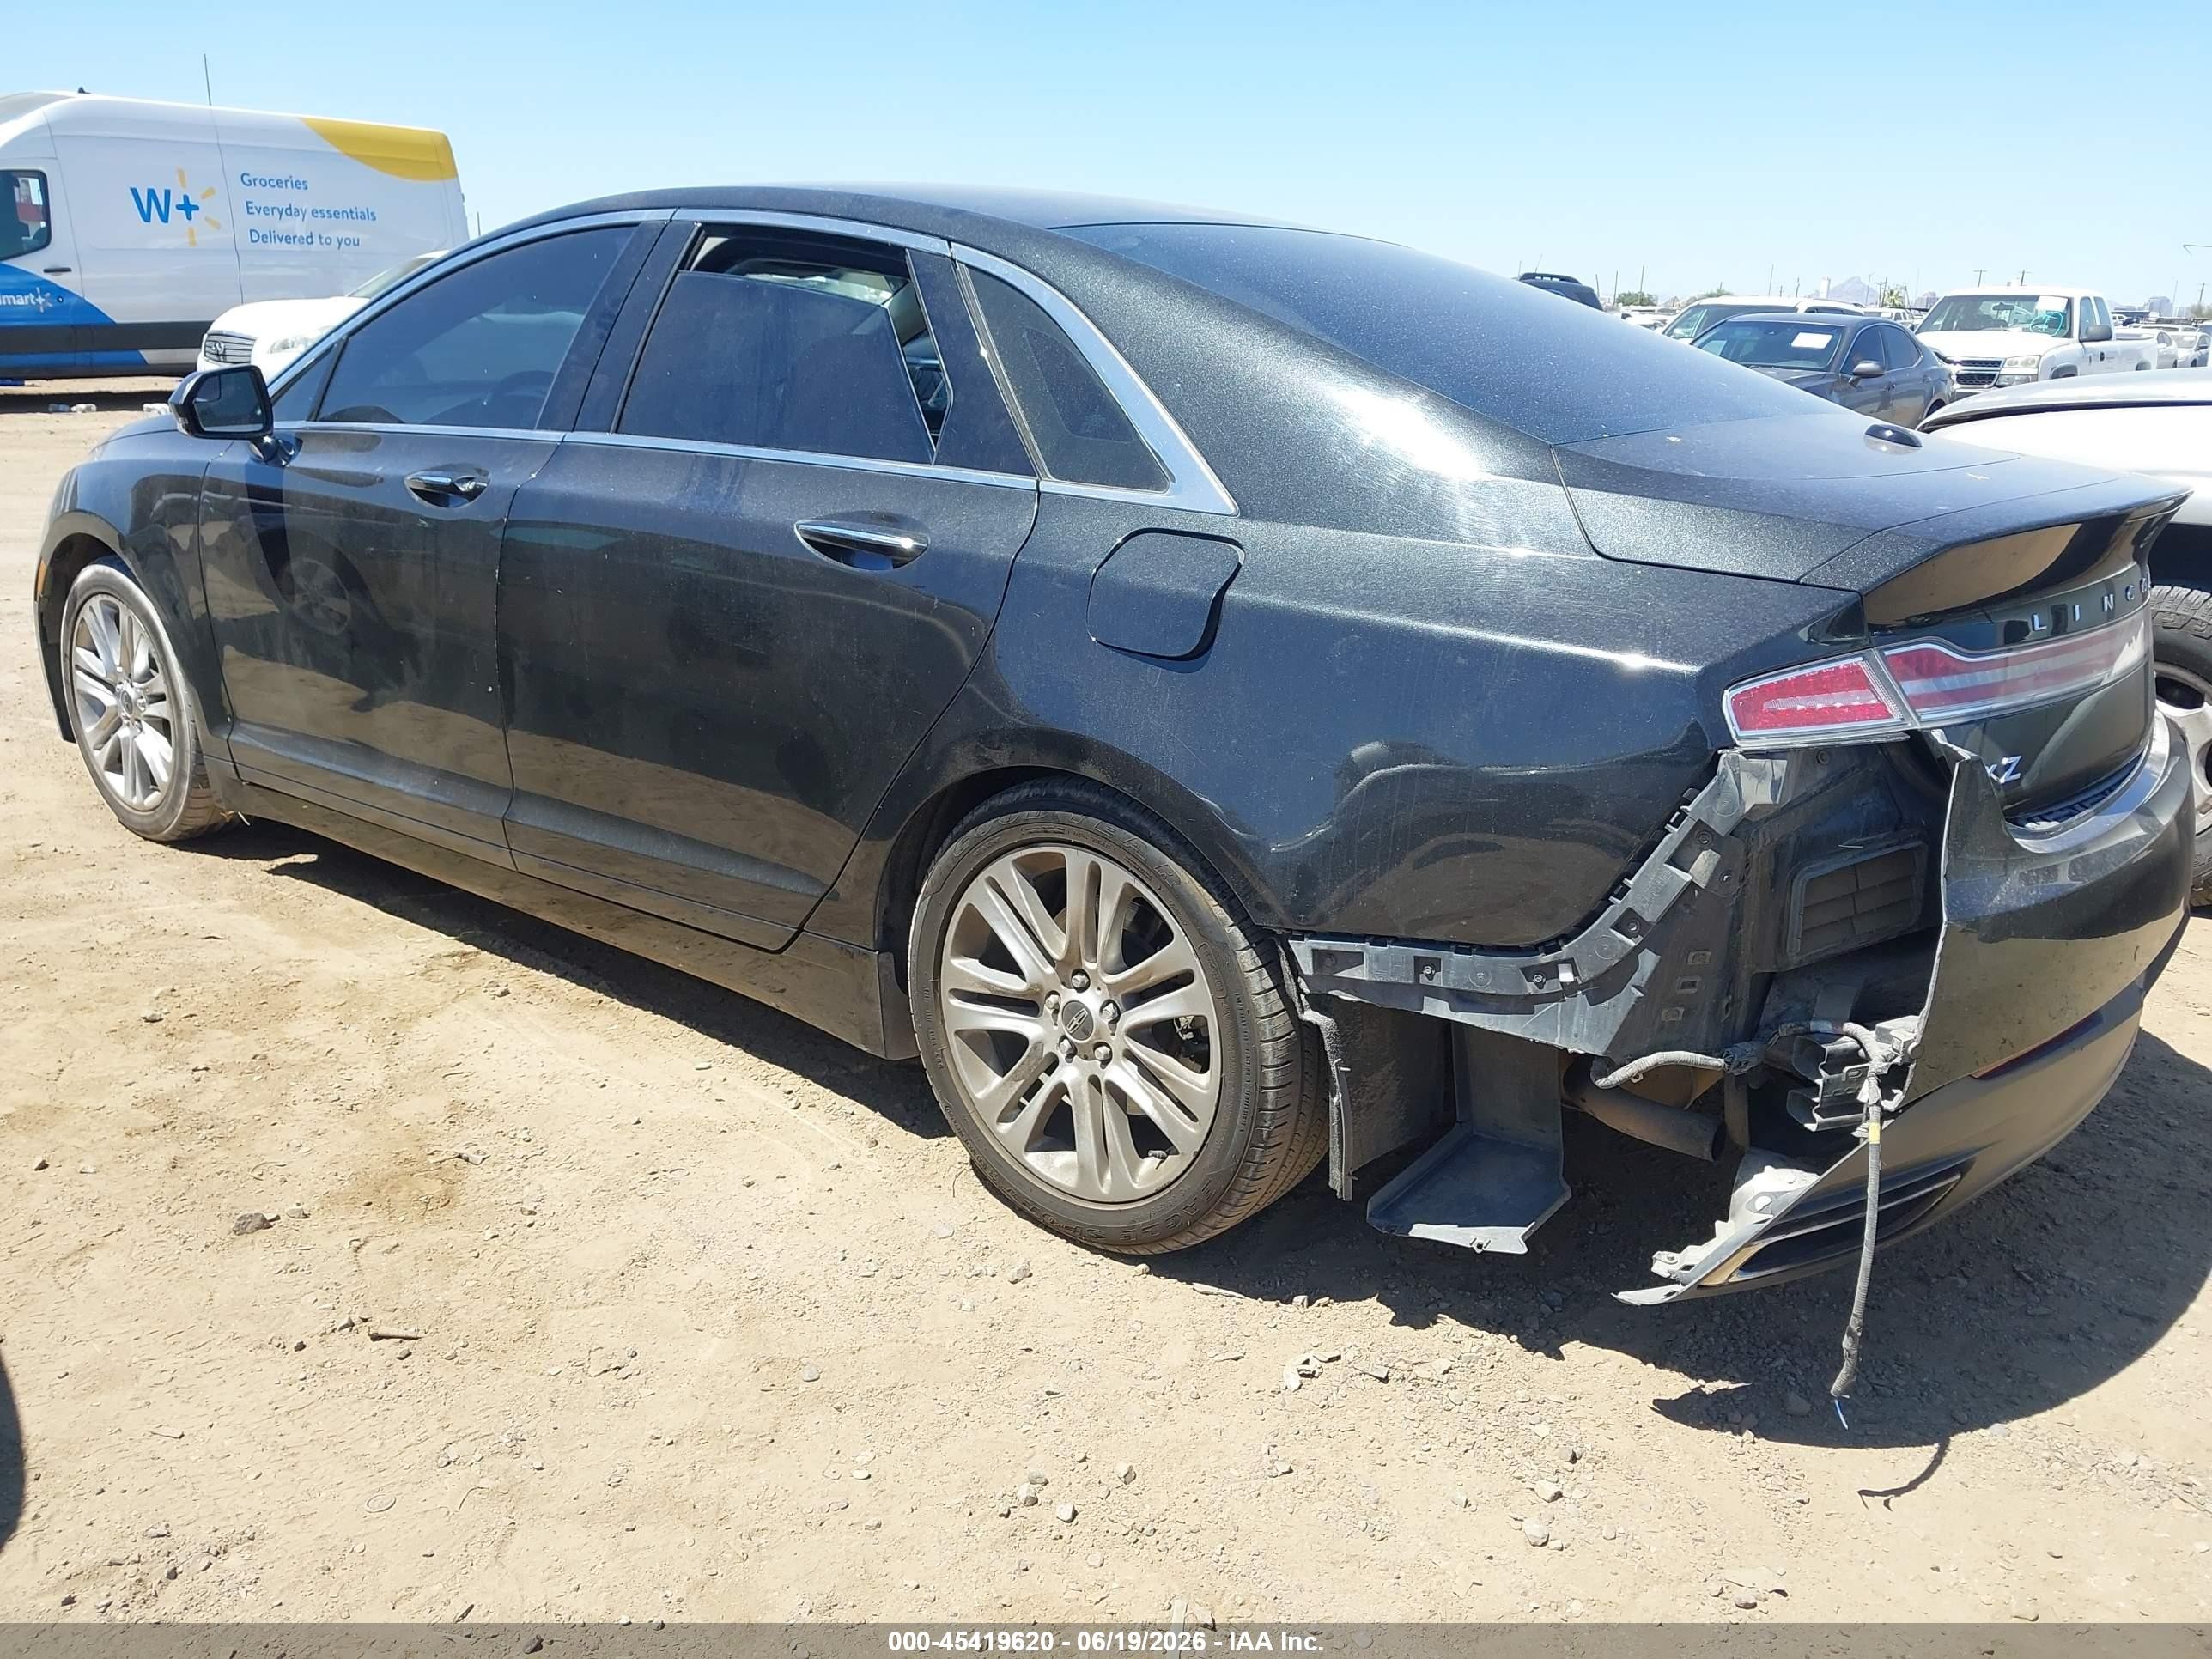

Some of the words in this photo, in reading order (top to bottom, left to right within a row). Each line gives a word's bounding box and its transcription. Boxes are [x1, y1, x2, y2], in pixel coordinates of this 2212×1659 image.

[240, 172, 308, 191] Groceries
[246, 201, 307, 222] Everyday
[311, 206, 377, 222] essentials
[249, 228, 314, 246] Delivered
[319, 233, 332, 246] to
[336, 236, 360, 250] you
